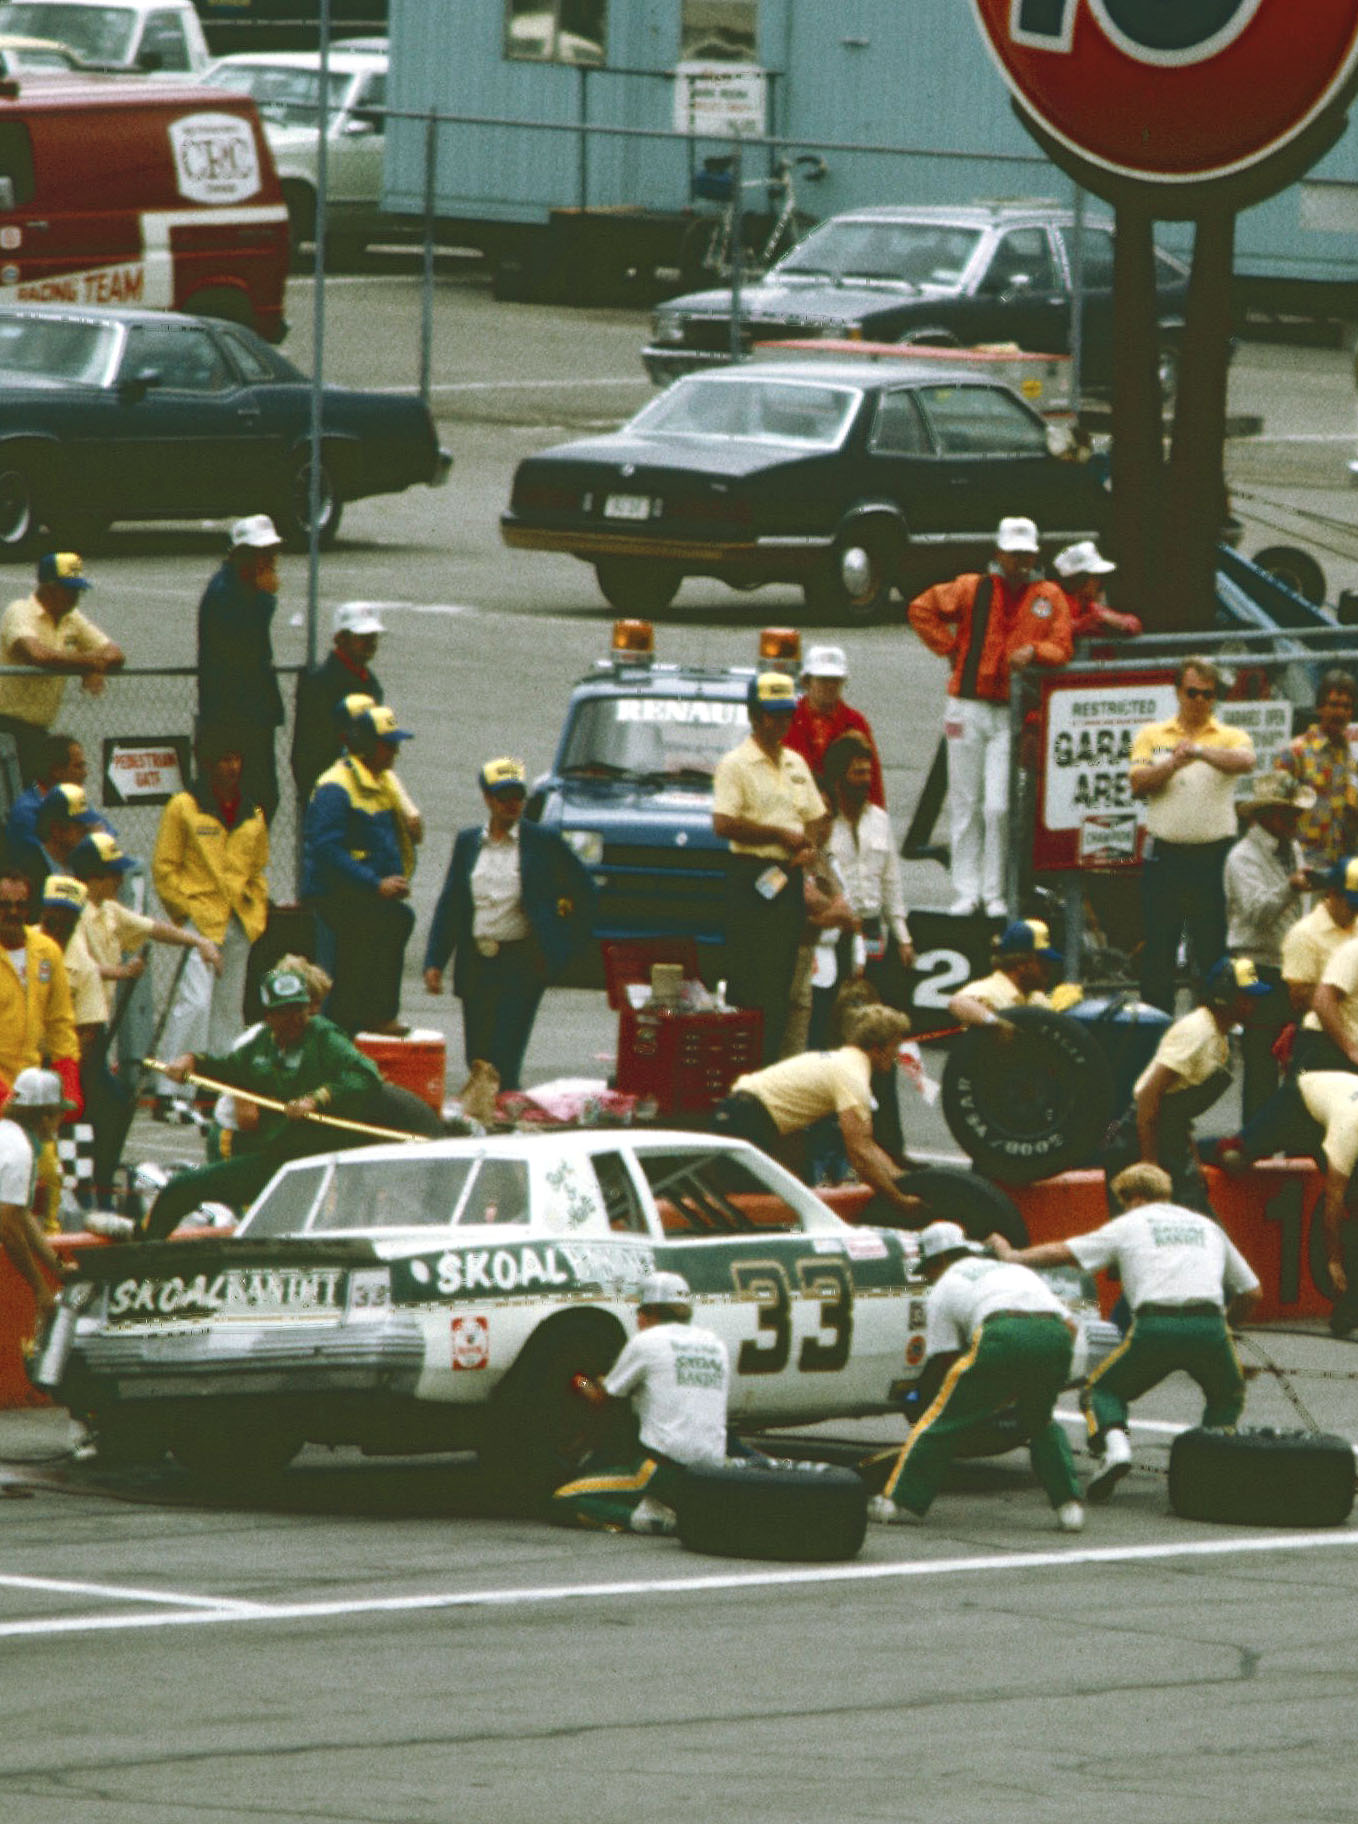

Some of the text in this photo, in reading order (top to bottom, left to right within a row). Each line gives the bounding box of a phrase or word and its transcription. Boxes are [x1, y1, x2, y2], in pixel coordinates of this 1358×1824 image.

[17, 265, 144, 302] RACING TEAM
[1072, 700, 1156, 716] RESTRICTED
[113, 752, 177, 769] PEDESTRIAN
[135, 771, 162, 787] GATE
[437, 1247, 567, 1293] SKOAL
[108, 1273, 227, 1314] SKOAL
[730, 1258, 853, 1375] 33
